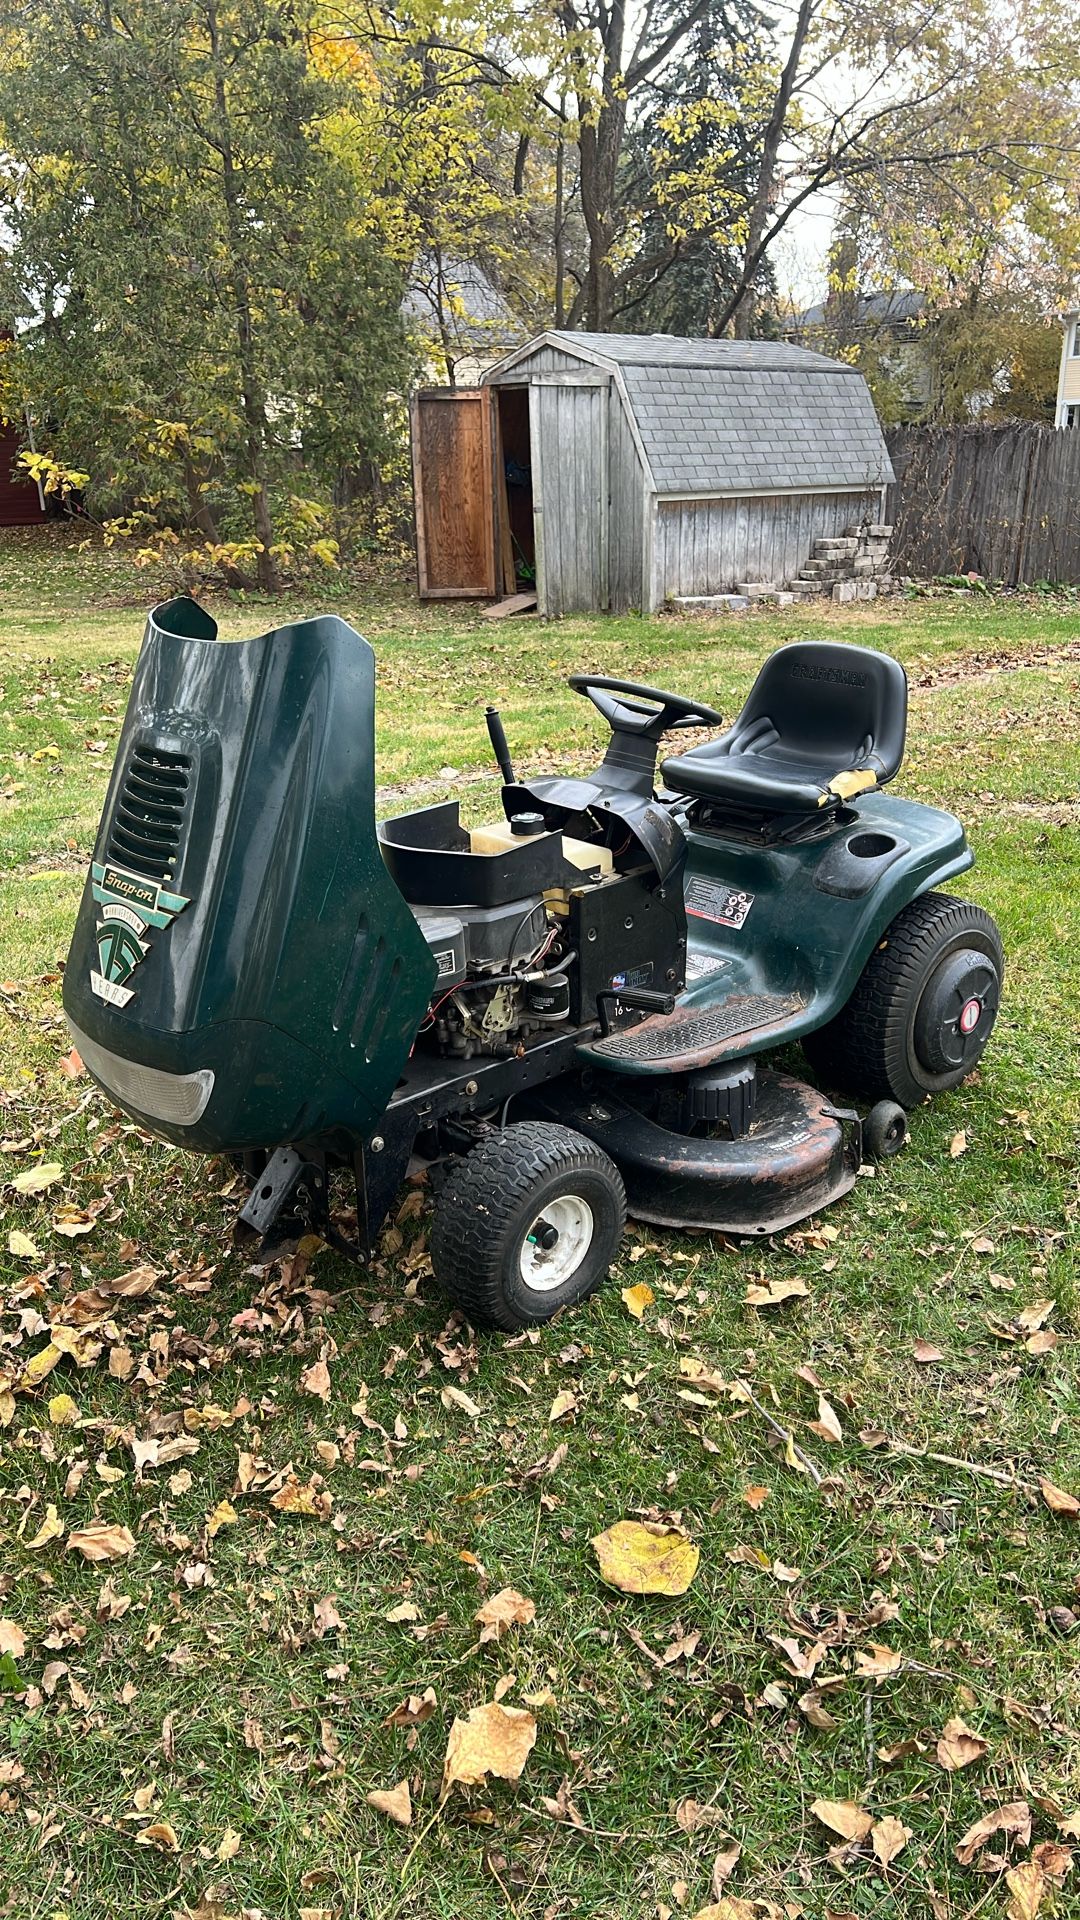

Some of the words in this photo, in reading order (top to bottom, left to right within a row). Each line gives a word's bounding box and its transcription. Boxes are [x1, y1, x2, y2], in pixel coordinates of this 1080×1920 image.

[791, 663, 865, 687] CRAFTSMAN
[92, 974, 129, 1004] YEARS
[614, 1006, 624, 1017] 16
